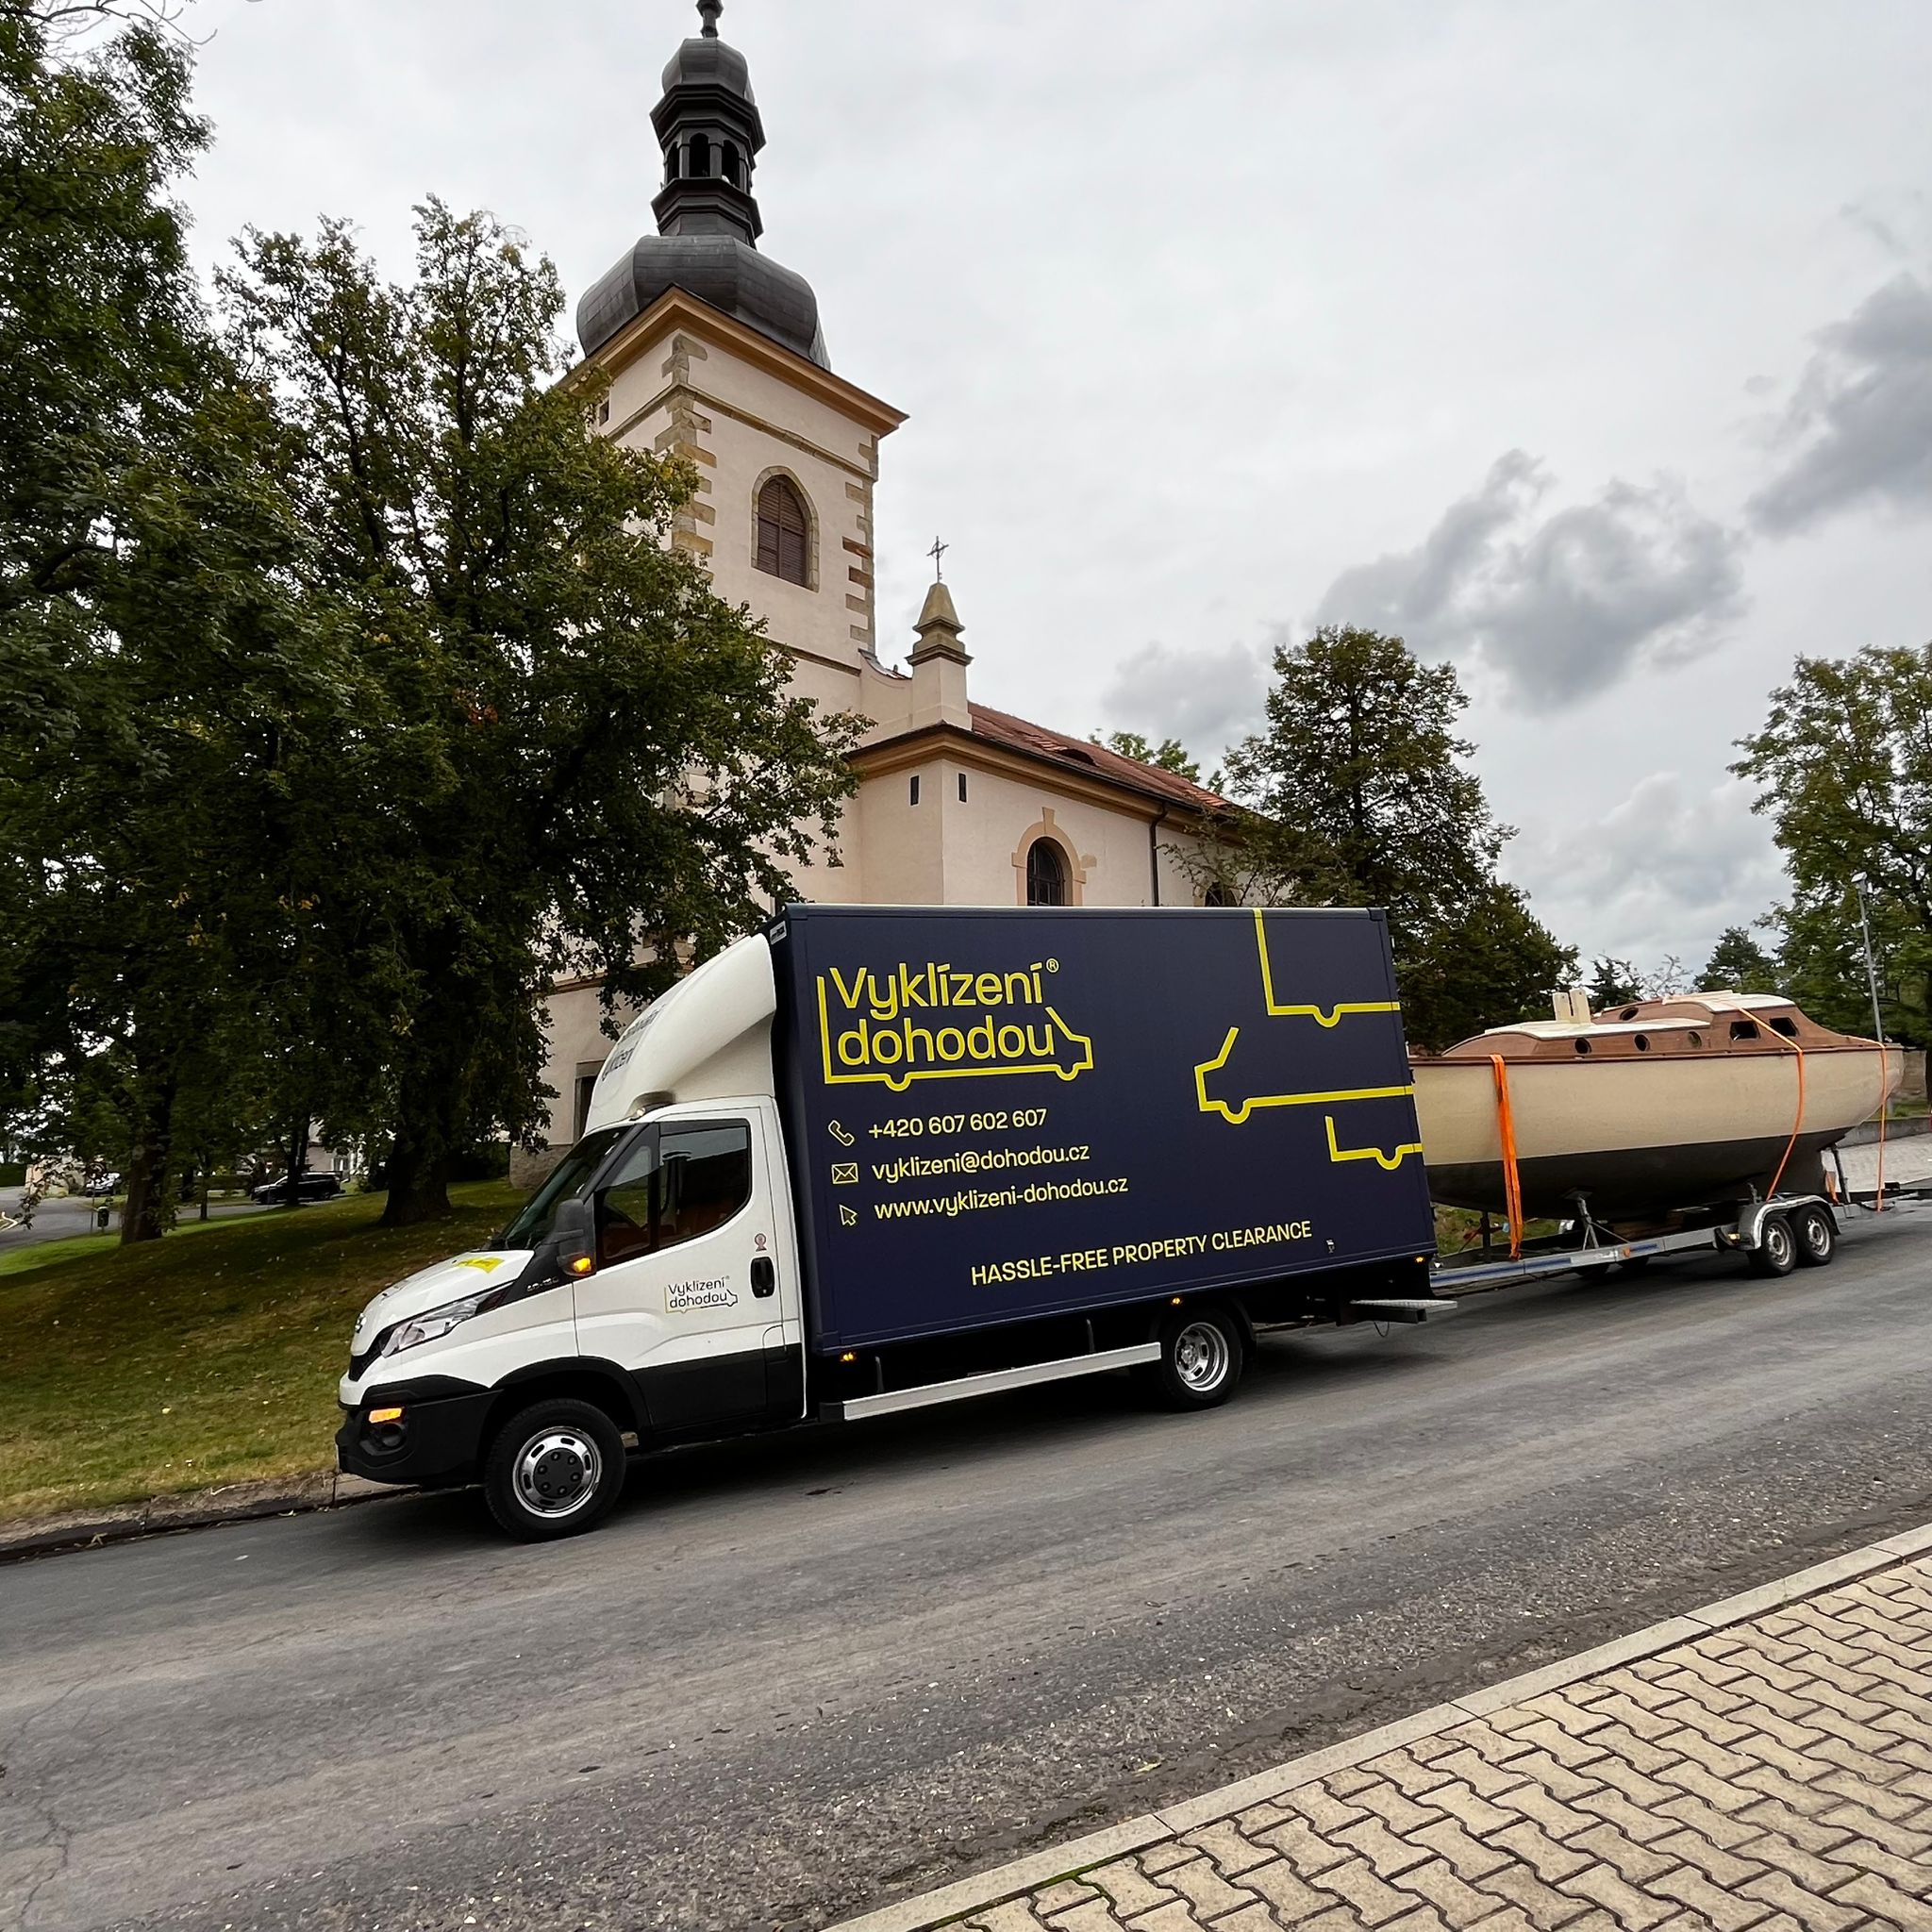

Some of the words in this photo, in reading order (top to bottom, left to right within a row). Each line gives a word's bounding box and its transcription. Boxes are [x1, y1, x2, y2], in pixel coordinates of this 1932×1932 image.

[838, 1014, 1055, 1066] dohodou
[868, 1117, 924, 1139] +420
[929, 1114, 965, 1135] 607
[970, 1111, 1008, 1131] 602
[1012, 1108, 1047, 1128] 607
[871, 1145, 1091, 1184] vyklizeni@dohodou.cz
[874, 1177, 1129, 1220] www.vyklizeni-dohodou.cz
[971, 1248, 1109, 1286] HASSLE-FREE
[1112, 1234, 1208, 1266] PROPERTY
[1211, 1220, 1312, 1251] CLEARANCE
[669, 1291, 727, 1308] dohodou
